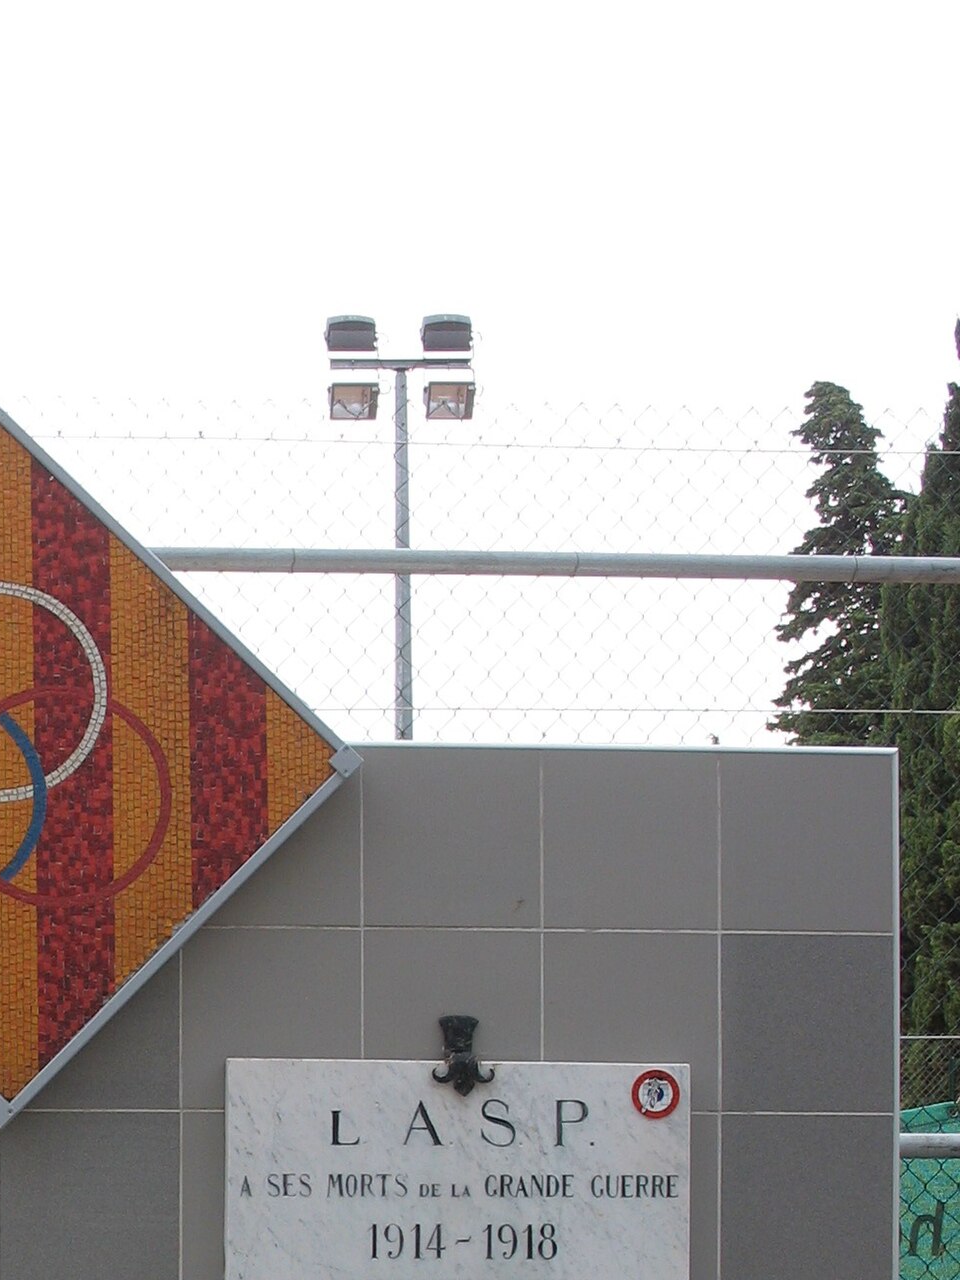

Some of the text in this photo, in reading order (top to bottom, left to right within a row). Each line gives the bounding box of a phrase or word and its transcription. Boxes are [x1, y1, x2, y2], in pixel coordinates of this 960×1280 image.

[267, 1174, 312, 1198] SES
[327, 1174, 408, 1198] MORTS
[484, 1175, 575, 1198] GRANDE
[590, 1175, 679, 1198] GUERRE
[368, 1223, 558, 1260] 1914 1918
